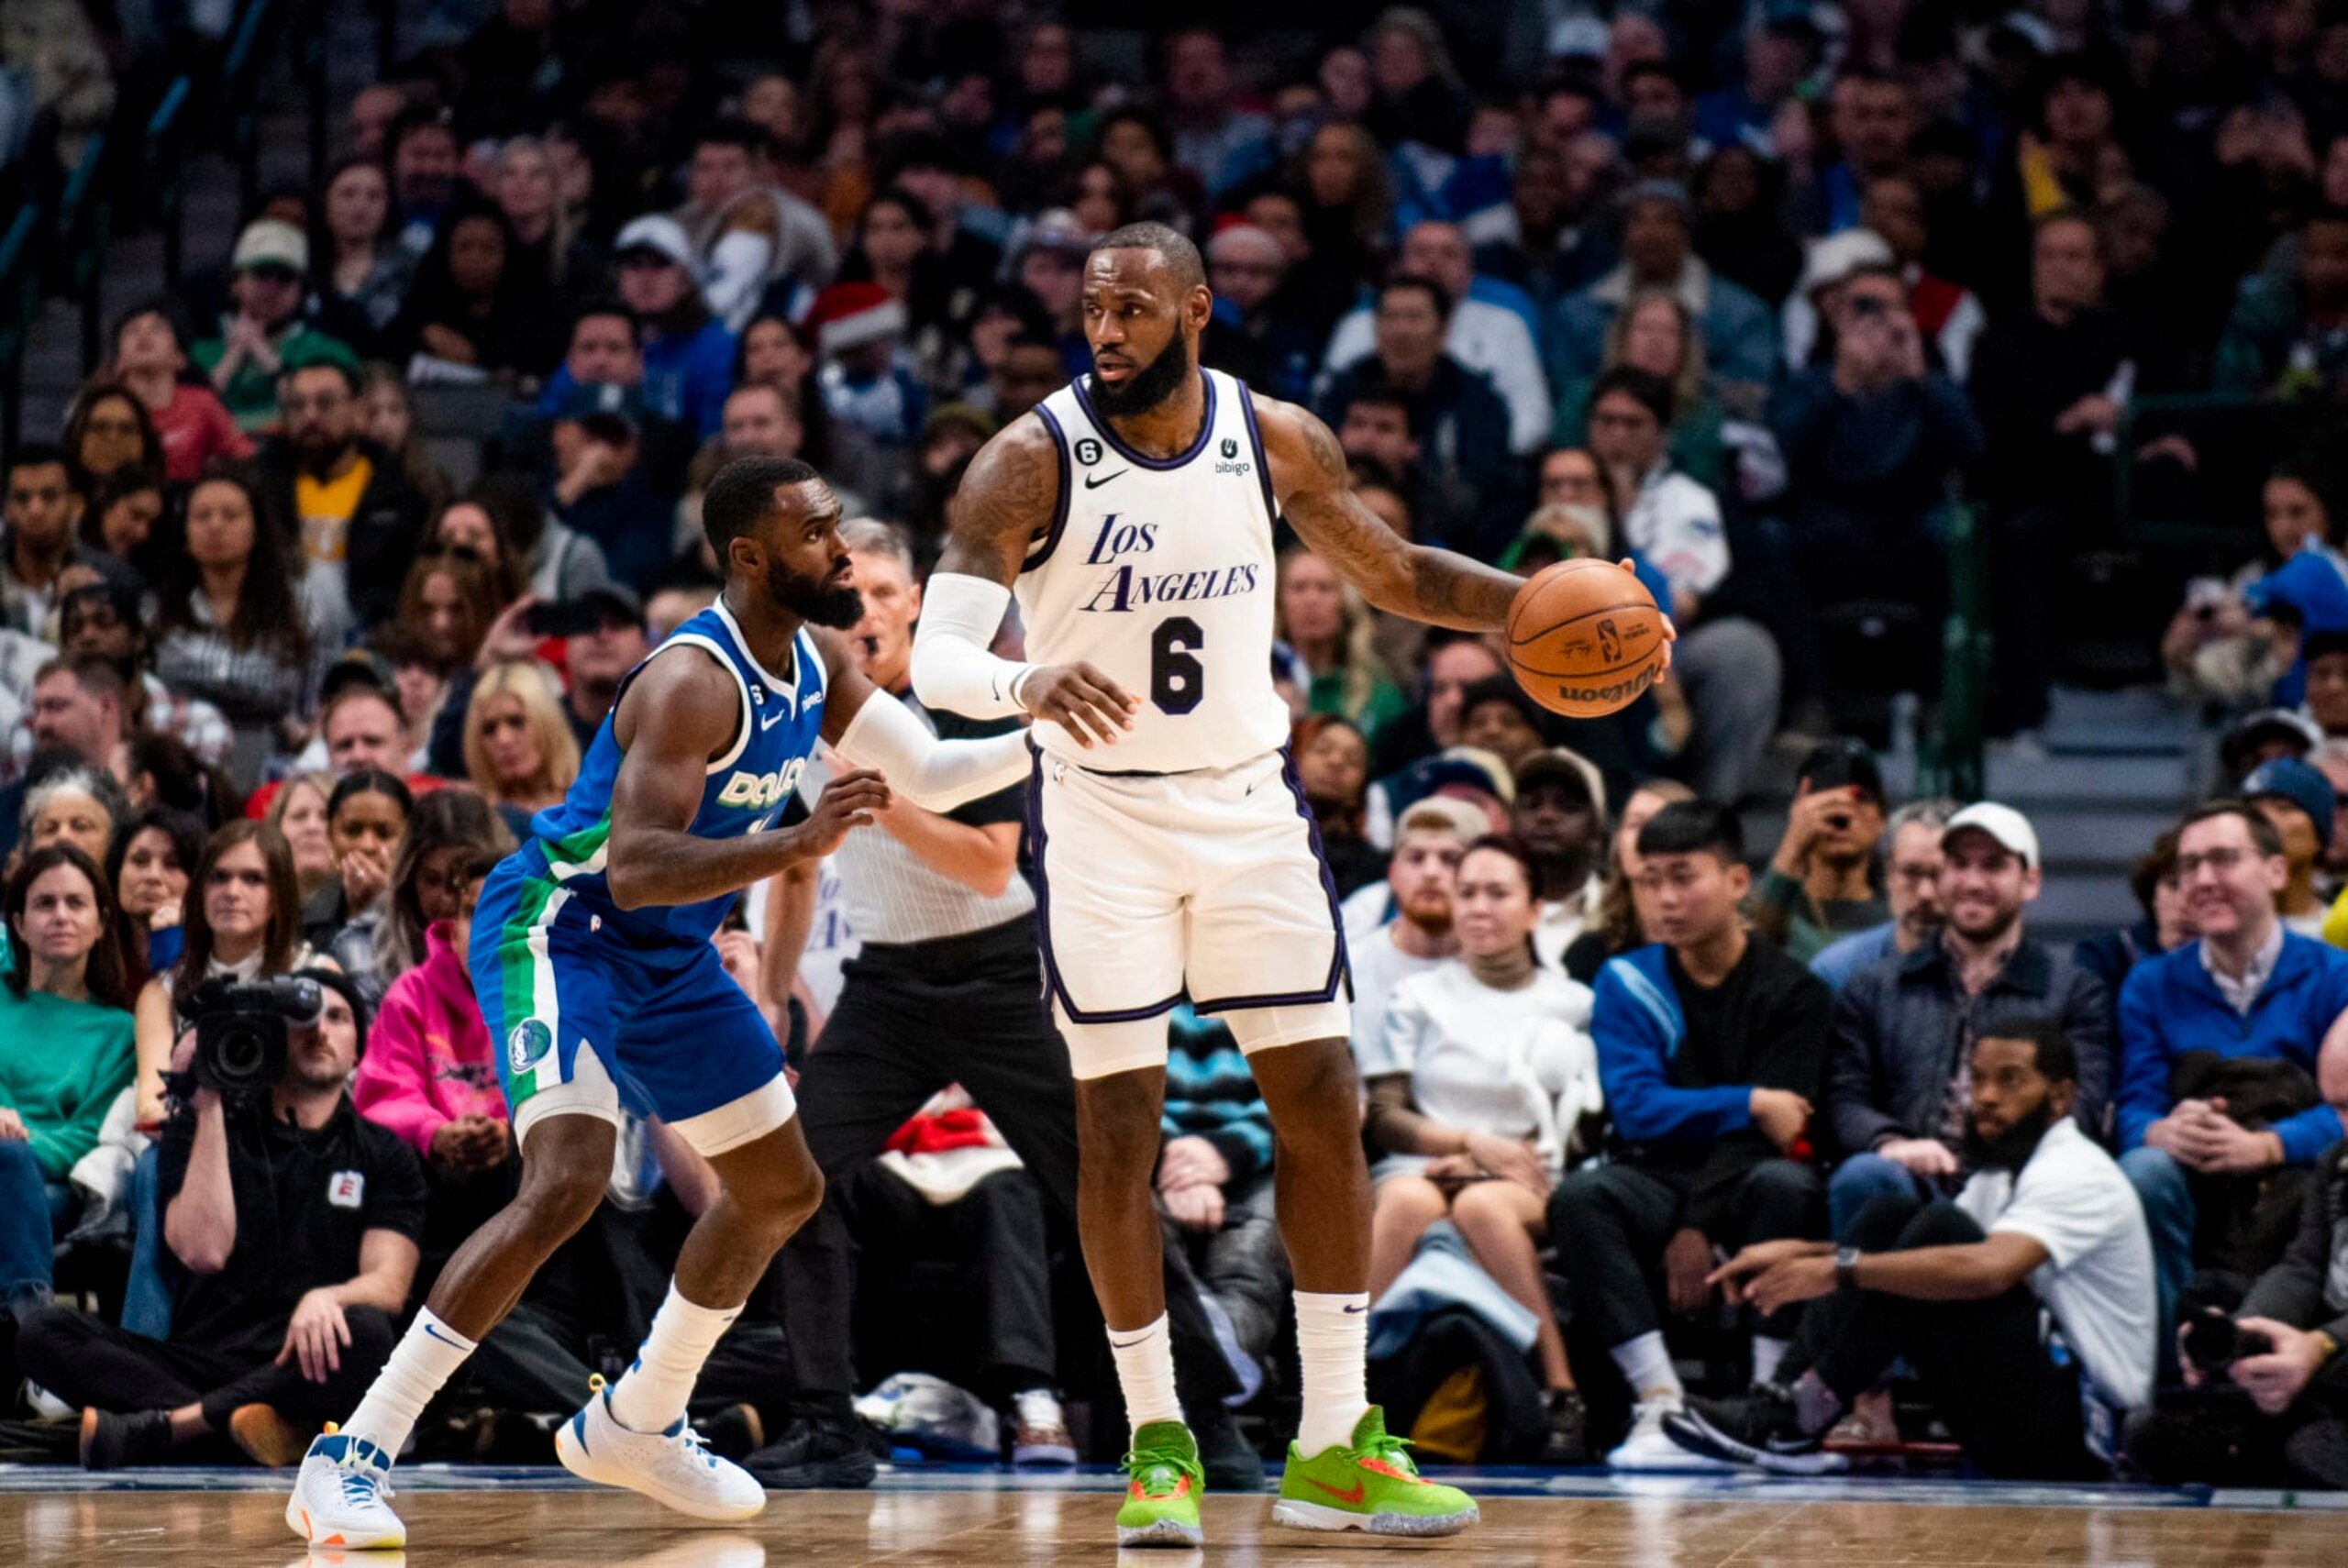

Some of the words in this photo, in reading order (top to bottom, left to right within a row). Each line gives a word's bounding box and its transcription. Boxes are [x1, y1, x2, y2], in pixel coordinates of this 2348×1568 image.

[1077, 440, 1101, 462] 6
[1215, 461, 1250, 476] bibigo
[1078, 563, 1258, 612] ANGELES
[1150, 615, 1204, 715] 6
